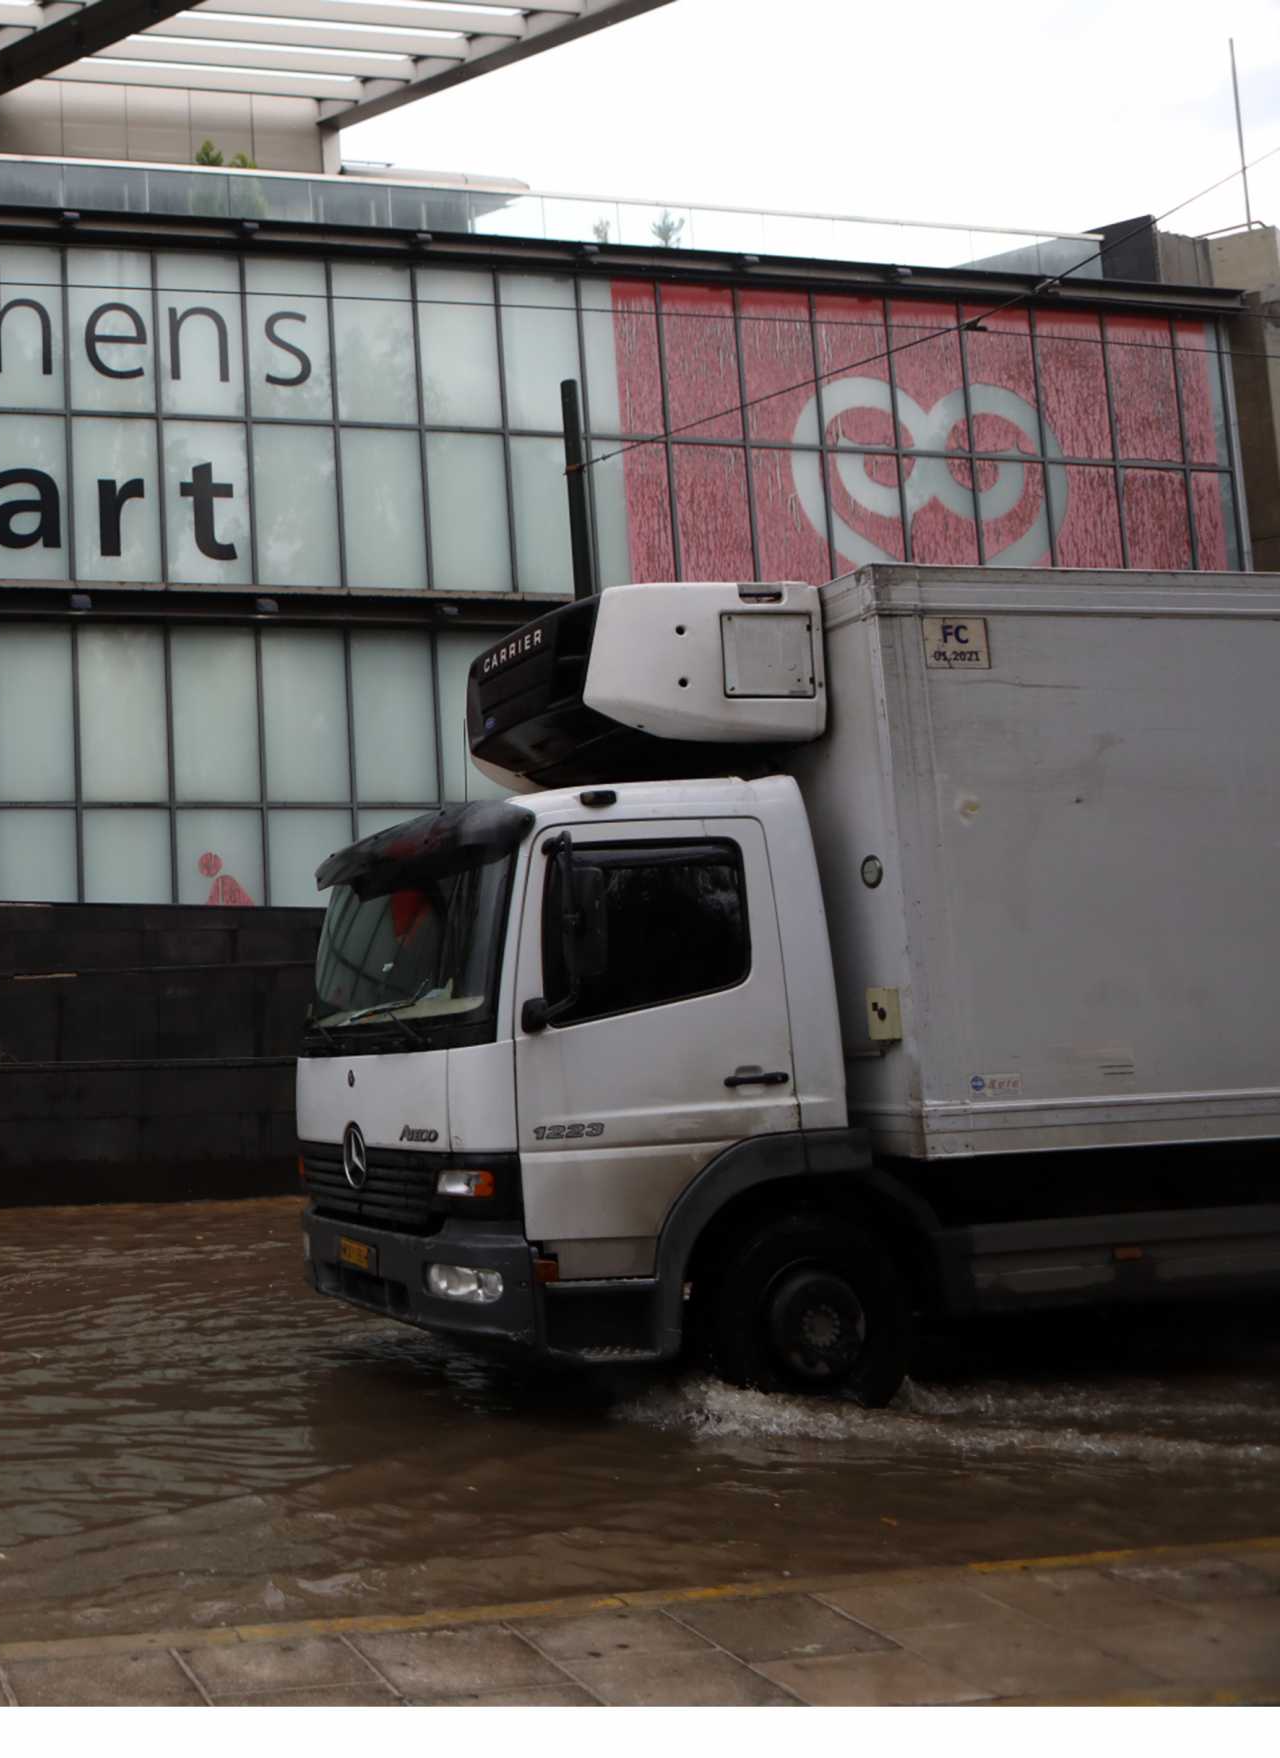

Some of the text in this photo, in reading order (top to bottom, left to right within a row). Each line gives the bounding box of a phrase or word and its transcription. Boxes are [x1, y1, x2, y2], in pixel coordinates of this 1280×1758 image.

[942, 624, 969, 644] FC
[483, 628, 542, 673] CARRIER
[532, 1122, 605, 1141] 1223
